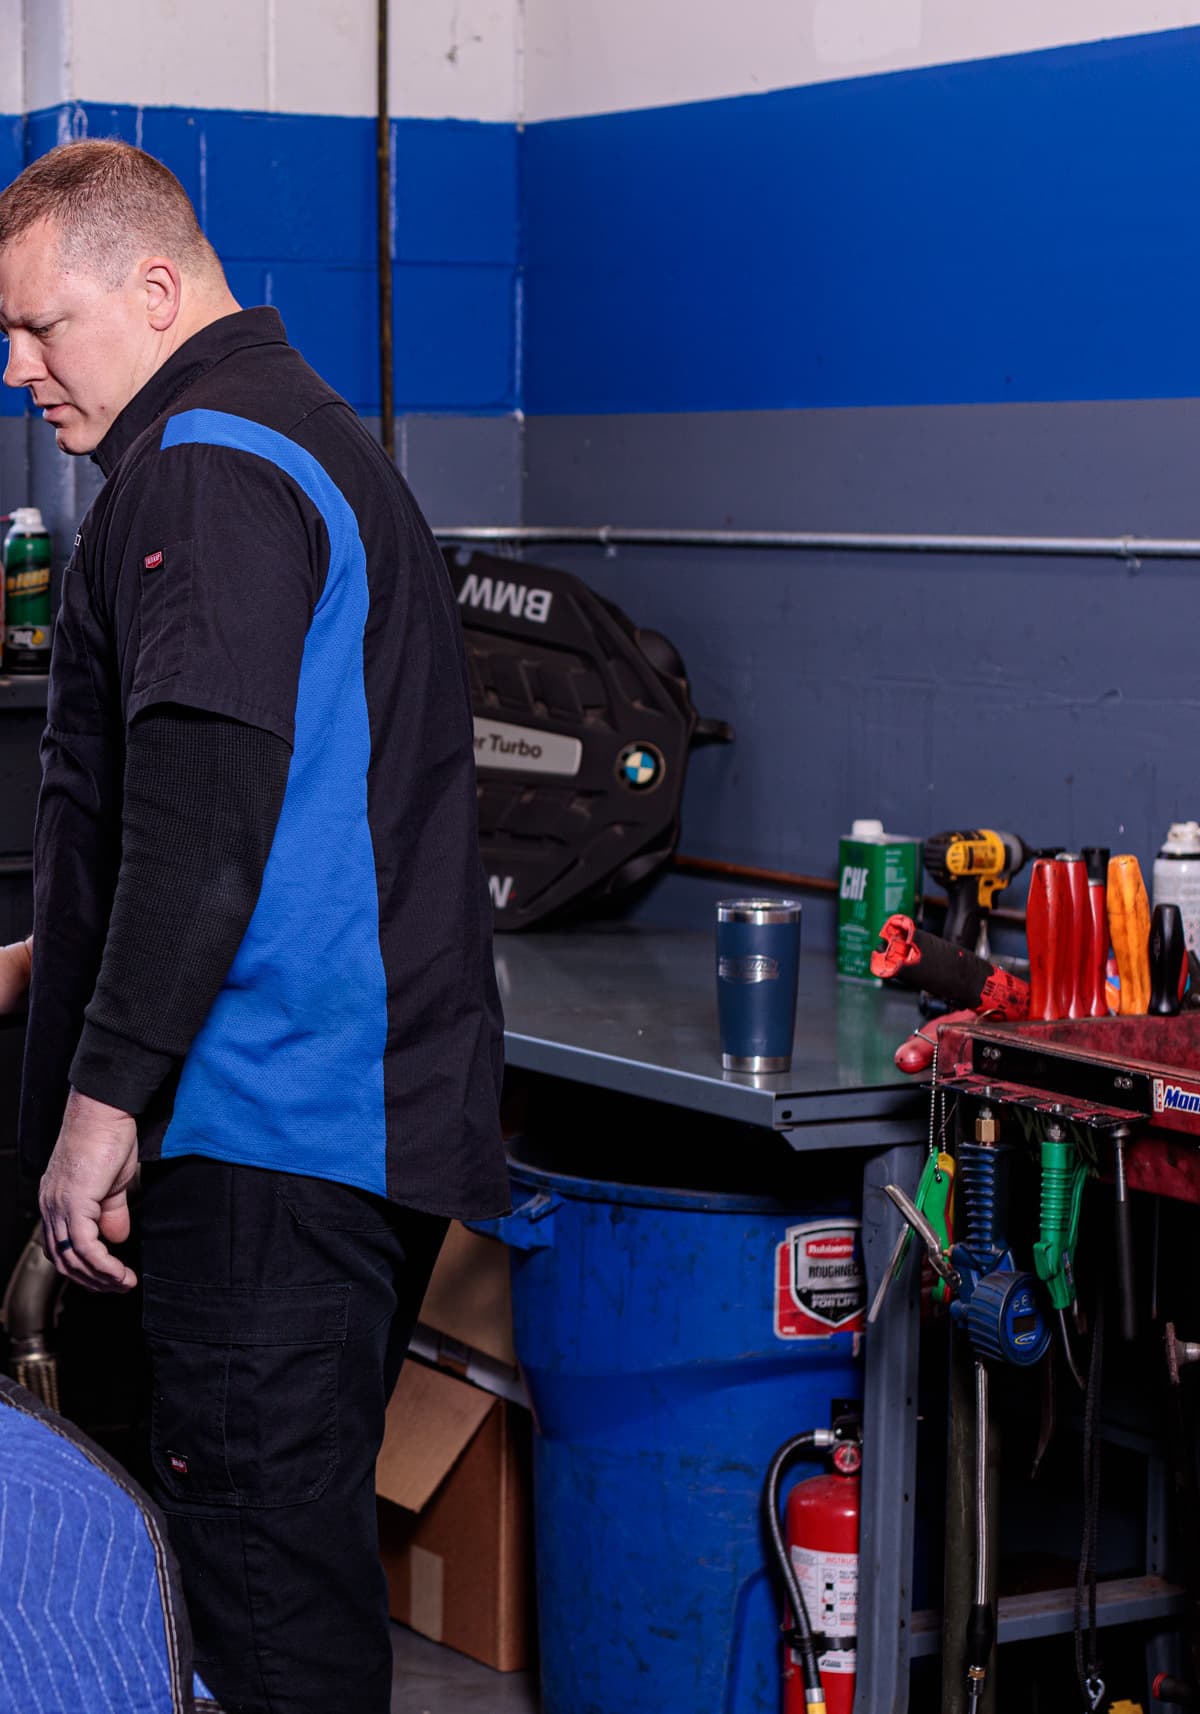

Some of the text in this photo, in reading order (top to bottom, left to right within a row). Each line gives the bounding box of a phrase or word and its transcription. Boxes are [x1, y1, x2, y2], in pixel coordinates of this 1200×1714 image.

[458, 574, 553, 623] BMW
[489, 733, 543, 759] Turbo
[840, 865, 869, 900] CHF
[1163, 1086, 1200, 1113] Mon
[808, 1265, 861, 1279] ROUGHNEC
